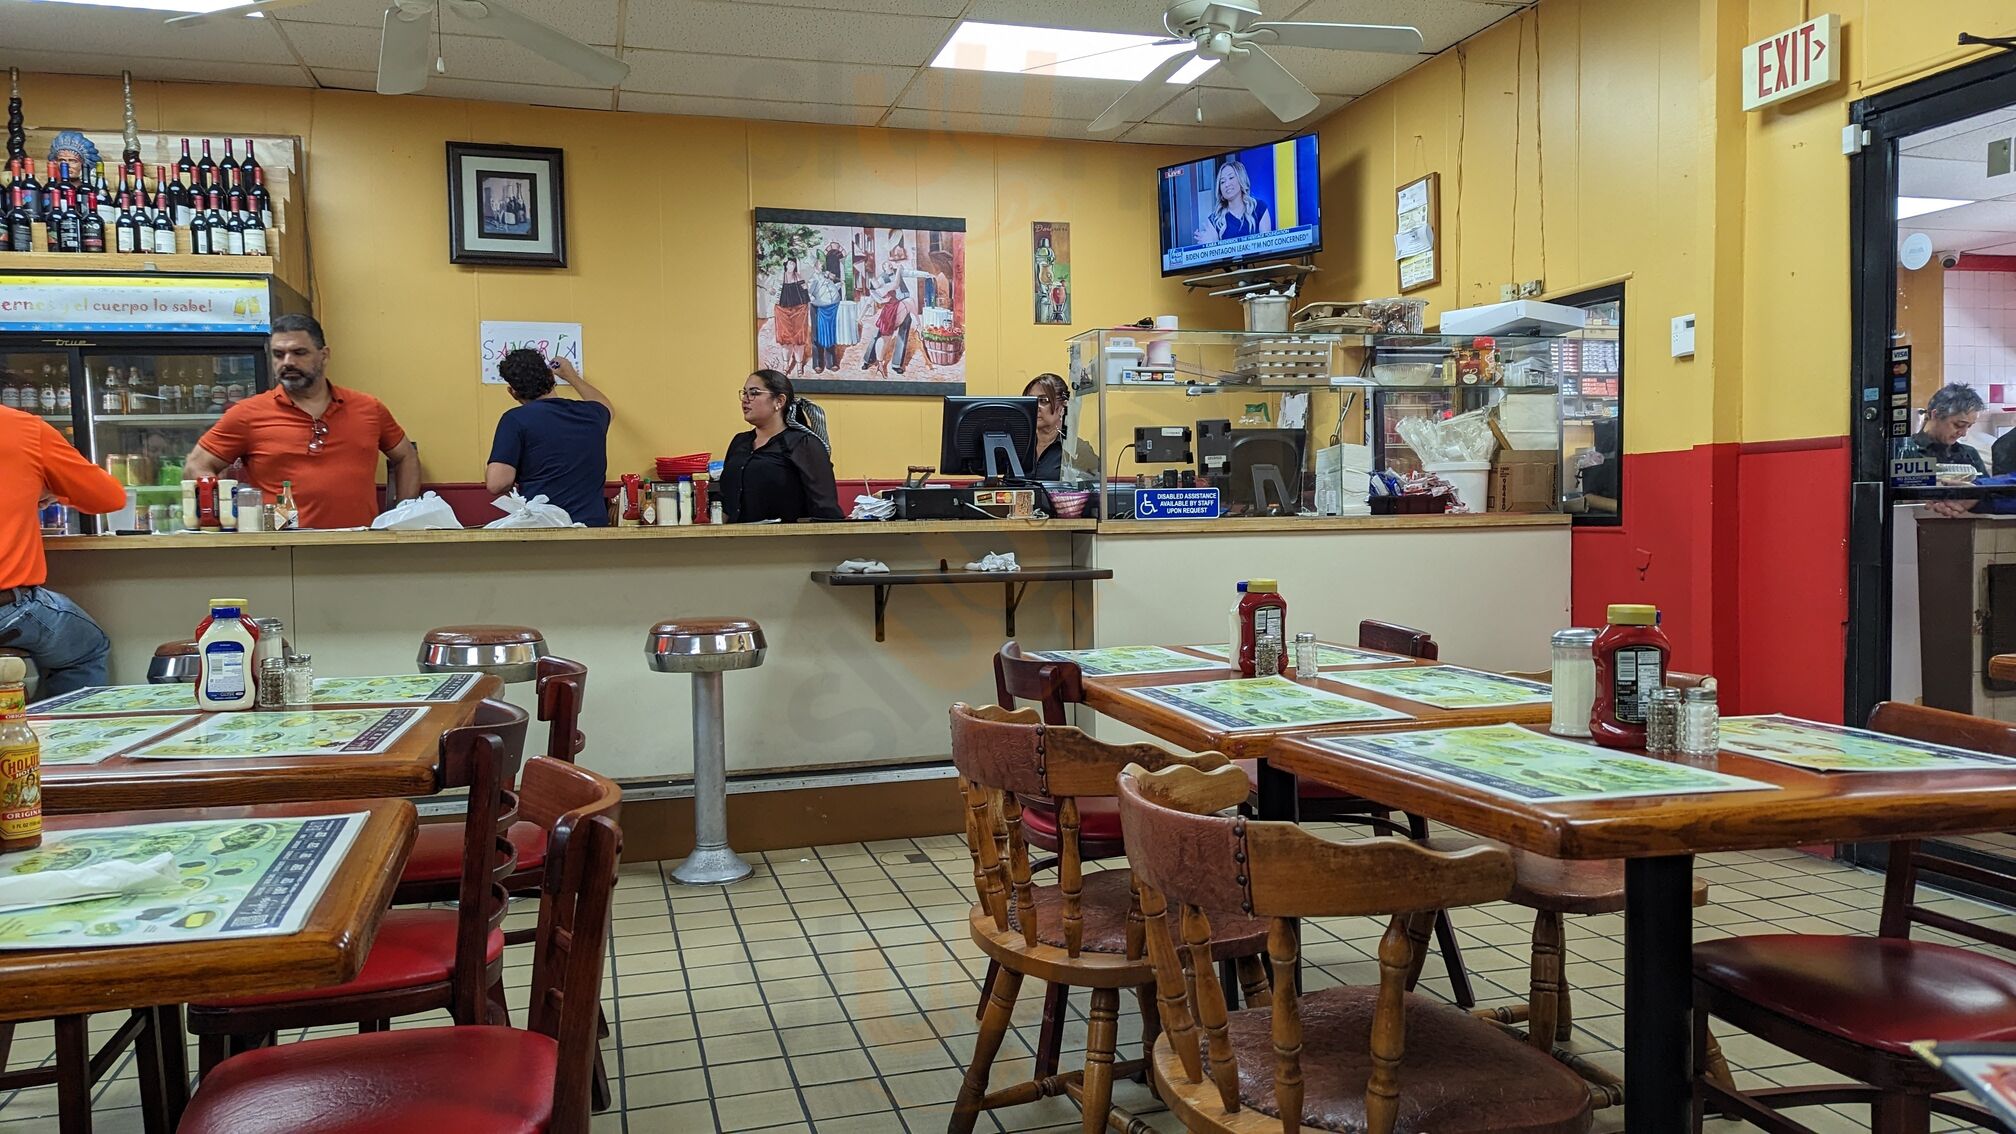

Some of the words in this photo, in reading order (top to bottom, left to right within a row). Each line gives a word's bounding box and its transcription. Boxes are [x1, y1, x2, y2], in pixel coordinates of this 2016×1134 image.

[1758, 23, 1815, 98] EXIT
[1167, 169, 1181, 178] LIVE
[1185, 252, 1200, 261] BIDEN
[1200, 250, 1209, 258] ON
[1209, 246, 1237, 257] PENTAGON
[1262, 239, 1274, 247] NOT
[1274, 232, 1309, 246] CONCERNED"
[75, 297, 89, 312] el
[93, 301, 149, 316] cuerpo
[153, 297, 169, 312] lo
[172, 298, 213, 313] sabe!
[1893, 350, 1909, 359] VISA
[1895, 461, 1933, 475] PULL
